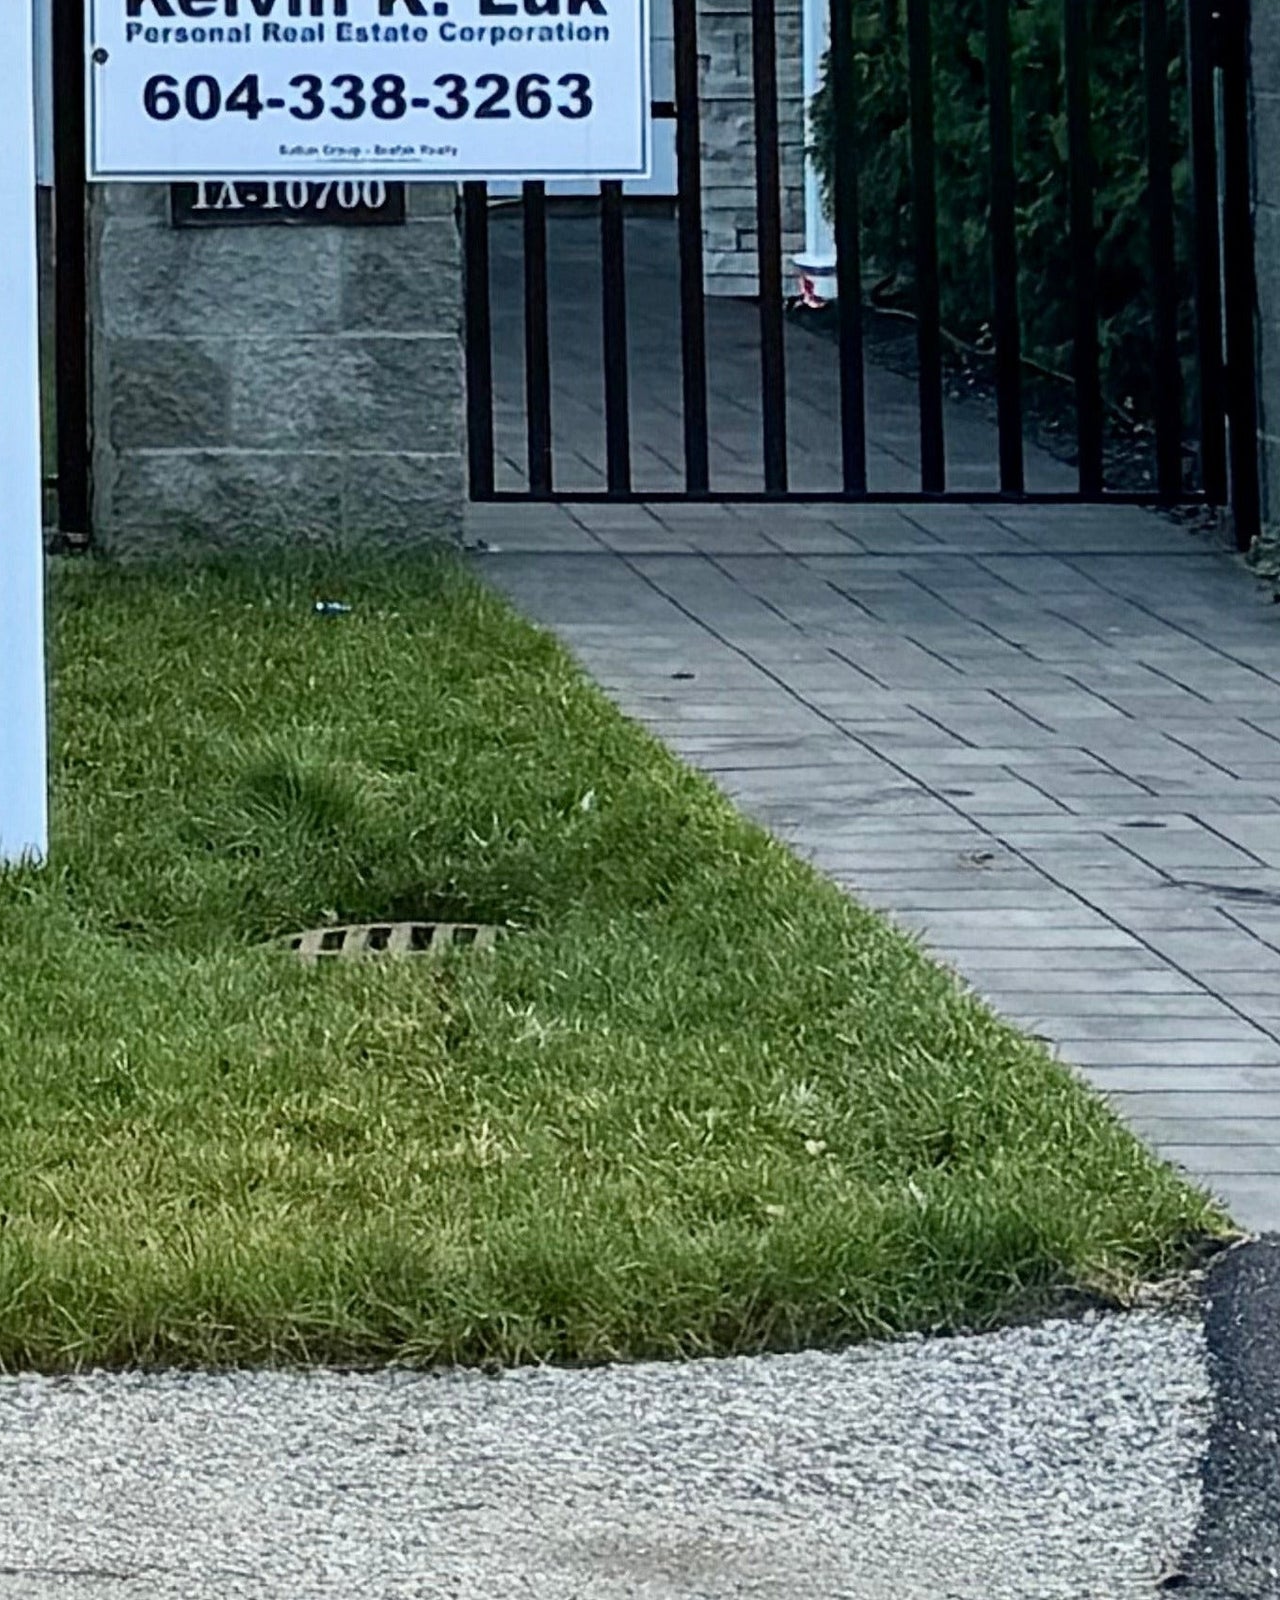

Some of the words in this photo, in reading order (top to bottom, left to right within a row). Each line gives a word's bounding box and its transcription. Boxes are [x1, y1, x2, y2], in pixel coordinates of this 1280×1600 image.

[126, 22, 251, 43] Personal
[263, 22, 325, 43] Real
[336, 22, 428, 43] Estate
[439, 22, 610, 47] Corporation
[143, 72, 593, 122] 604-338-3263
